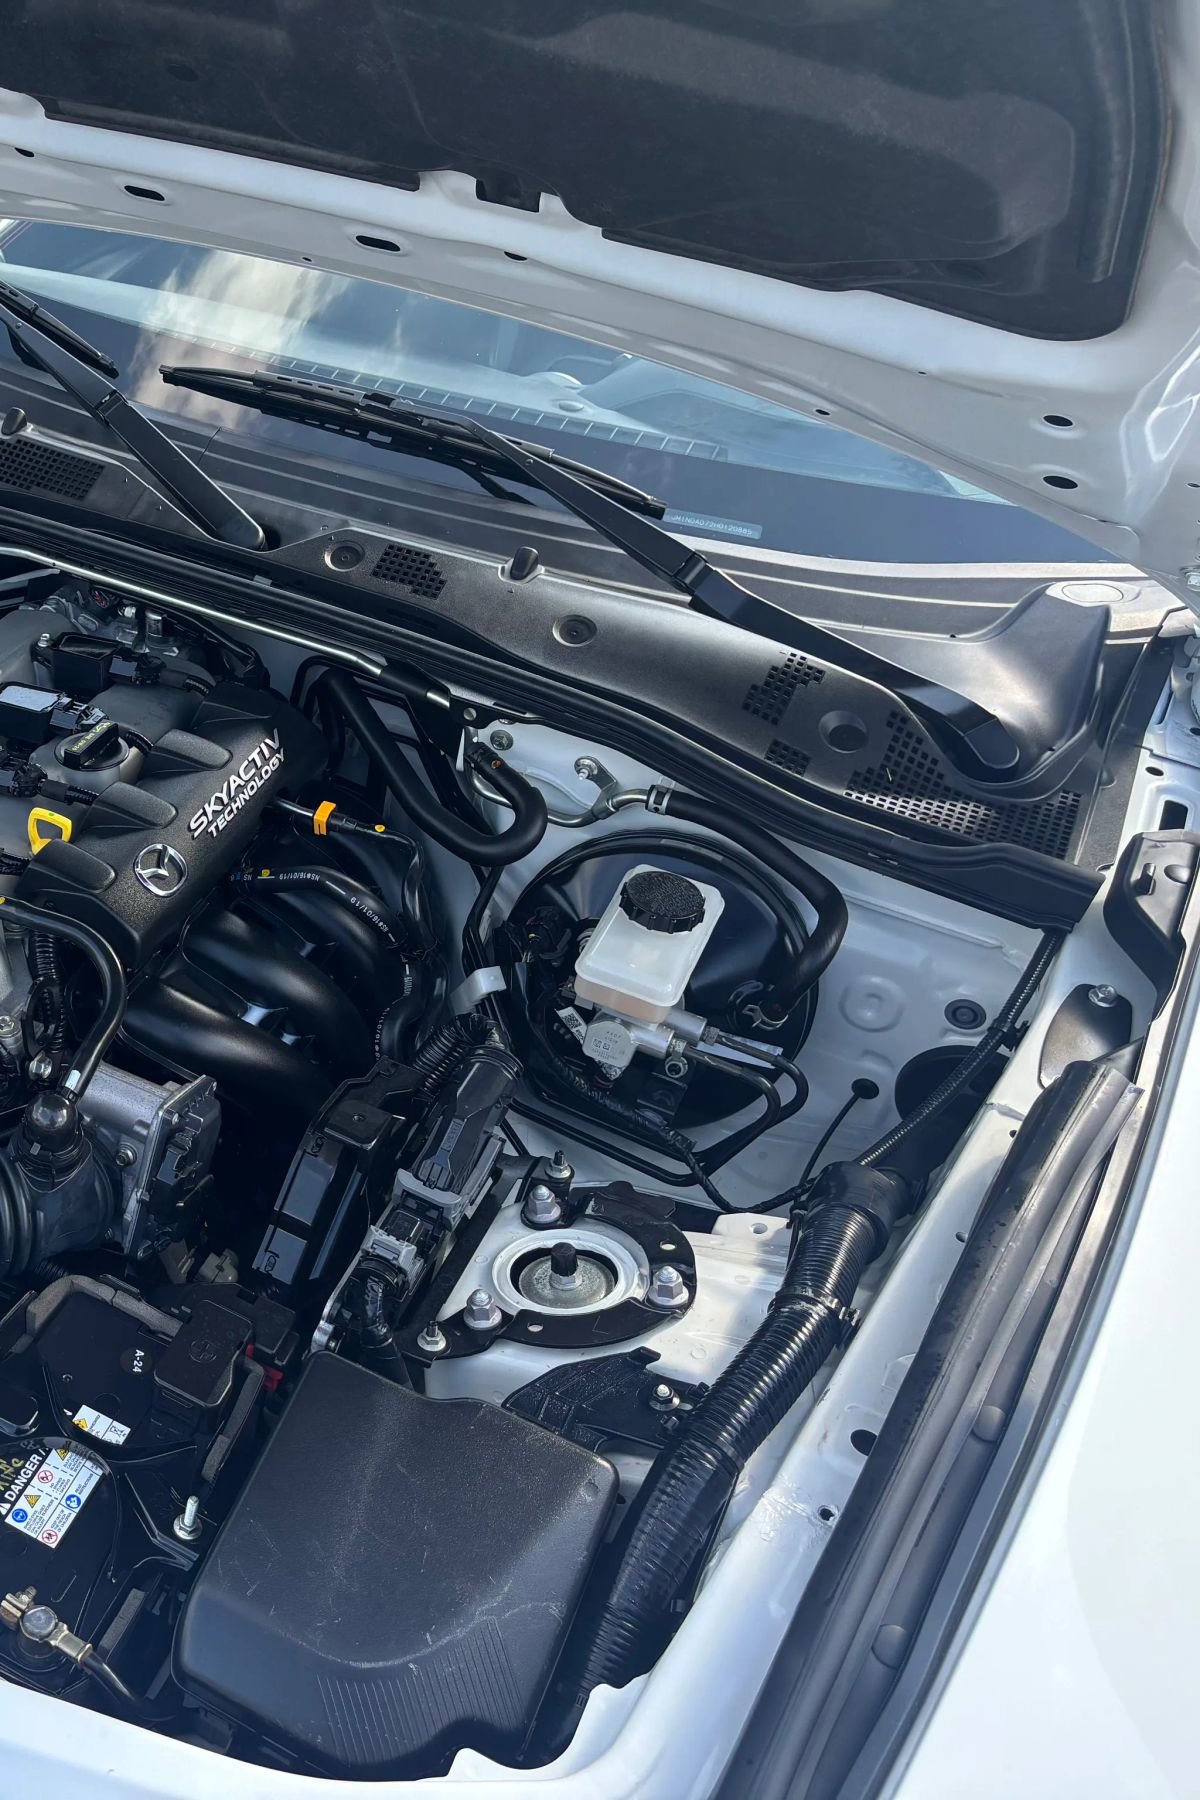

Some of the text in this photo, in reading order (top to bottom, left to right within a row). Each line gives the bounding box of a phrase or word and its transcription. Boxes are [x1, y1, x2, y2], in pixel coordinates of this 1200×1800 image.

[189, 728, 280, 838] SKYACTIV
[207, 747, 285, 838] TECHNOLOGY
[132, 1349, 145, 1373] A-24
[4, 1453, 43, 1502] DANGER
